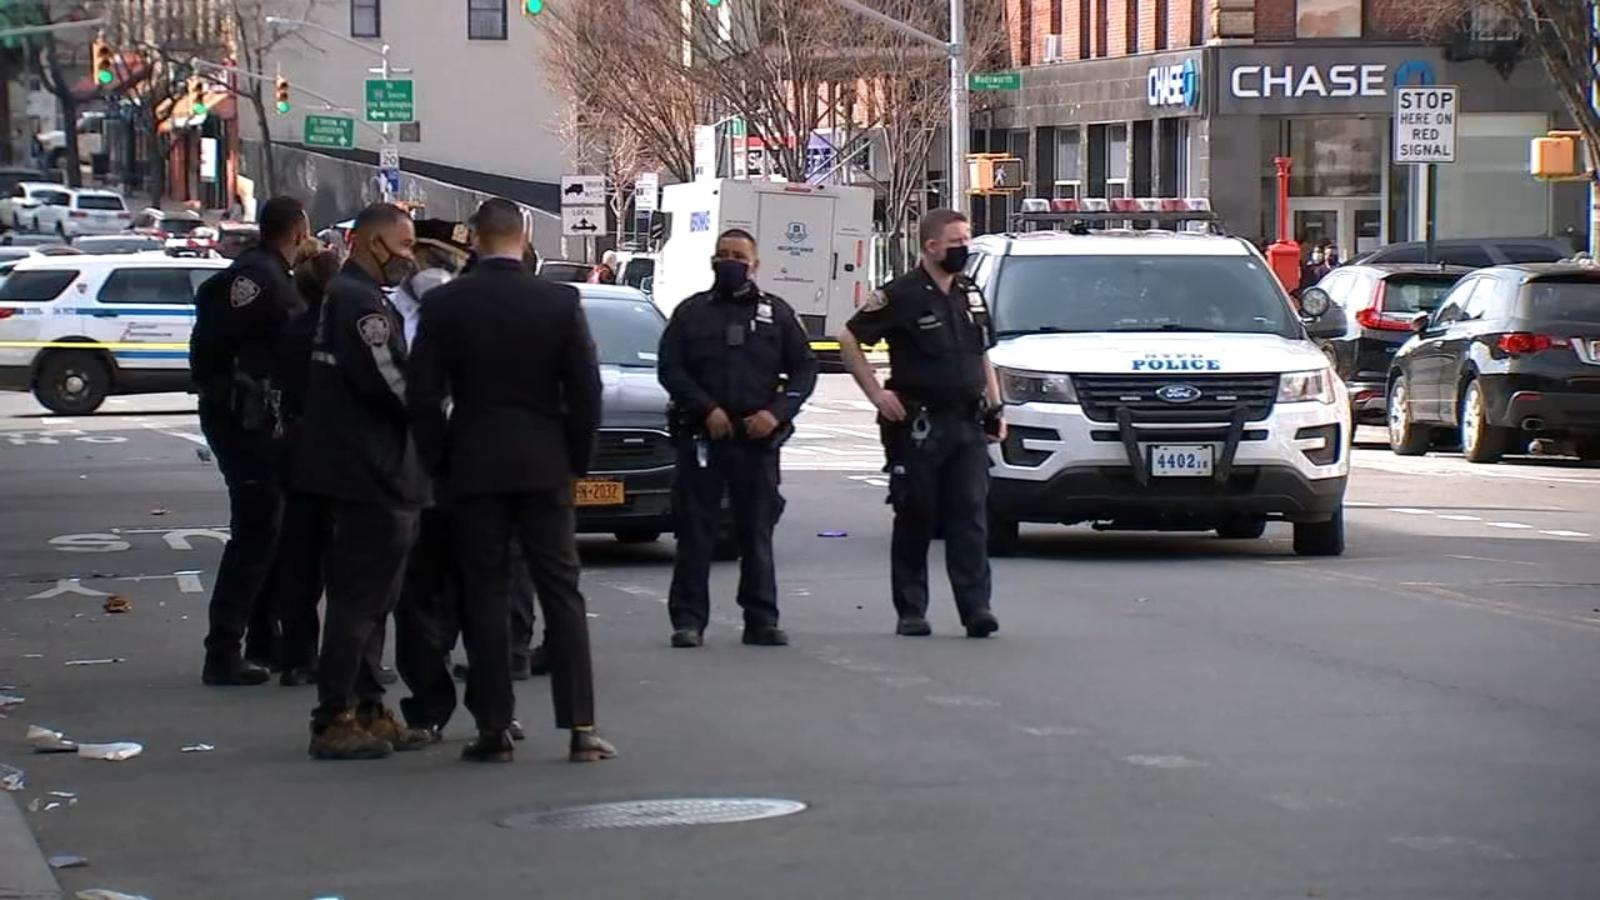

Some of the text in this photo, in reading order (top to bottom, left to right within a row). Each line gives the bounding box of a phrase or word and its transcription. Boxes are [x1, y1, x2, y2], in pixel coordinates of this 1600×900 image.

[1148, 65, 1184, 106] CHASE
[1231, 64, 1388, 98] CHASE
[1400, 91, 1453, 109] STOP
[1400, 113, 1452, 125] HERE ON
[1412, 128, 1440, 141] RED
[1400, 144, 1451, 157] SIGNAL
[1131, 359, 1221, 371] POLICE
[1157, 453, 1196, 469] 4402
